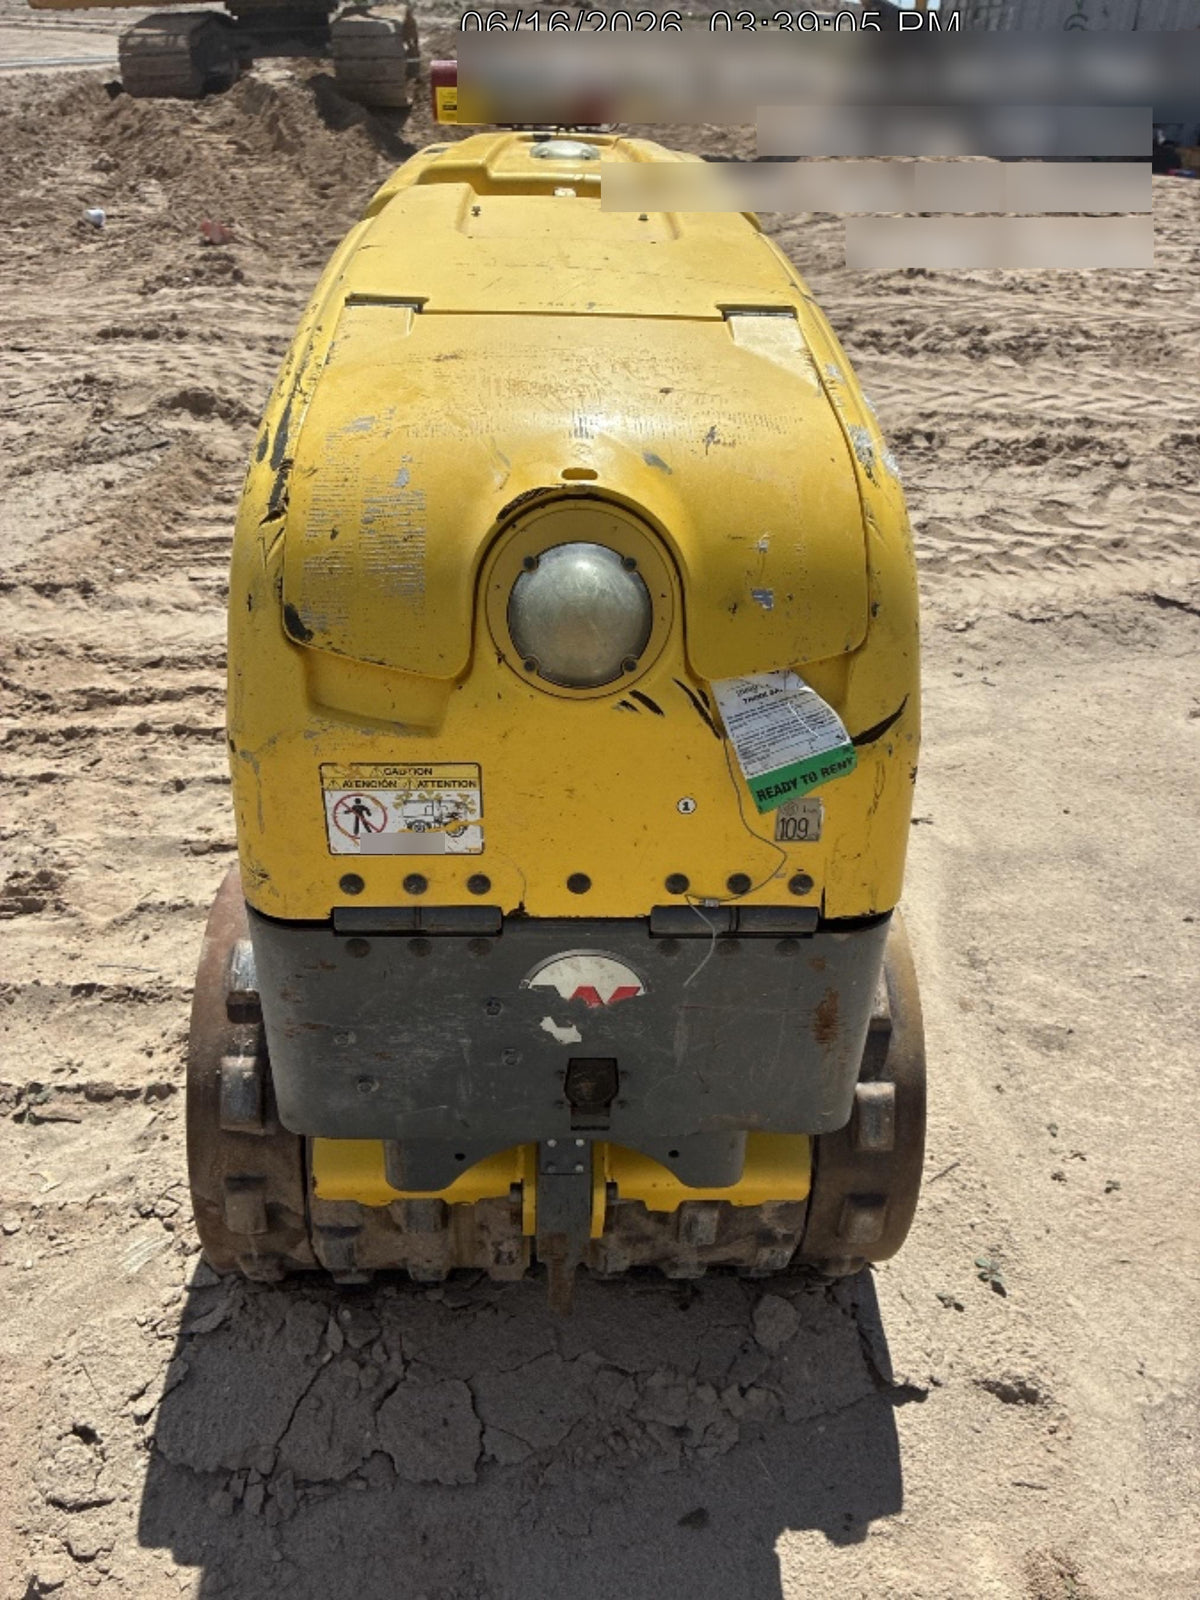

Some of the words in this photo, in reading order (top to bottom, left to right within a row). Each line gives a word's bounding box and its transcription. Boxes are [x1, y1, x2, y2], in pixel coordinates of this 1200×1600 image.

[417, 779, 477, 788] ATTENTION
[756, 777, 798, 802] READY
[800, 771, 818, 785] TO
[821, 757, 853, 778] RENT
[682, 801, 691, 811] 1
[780, 817, 808, 840] 109
